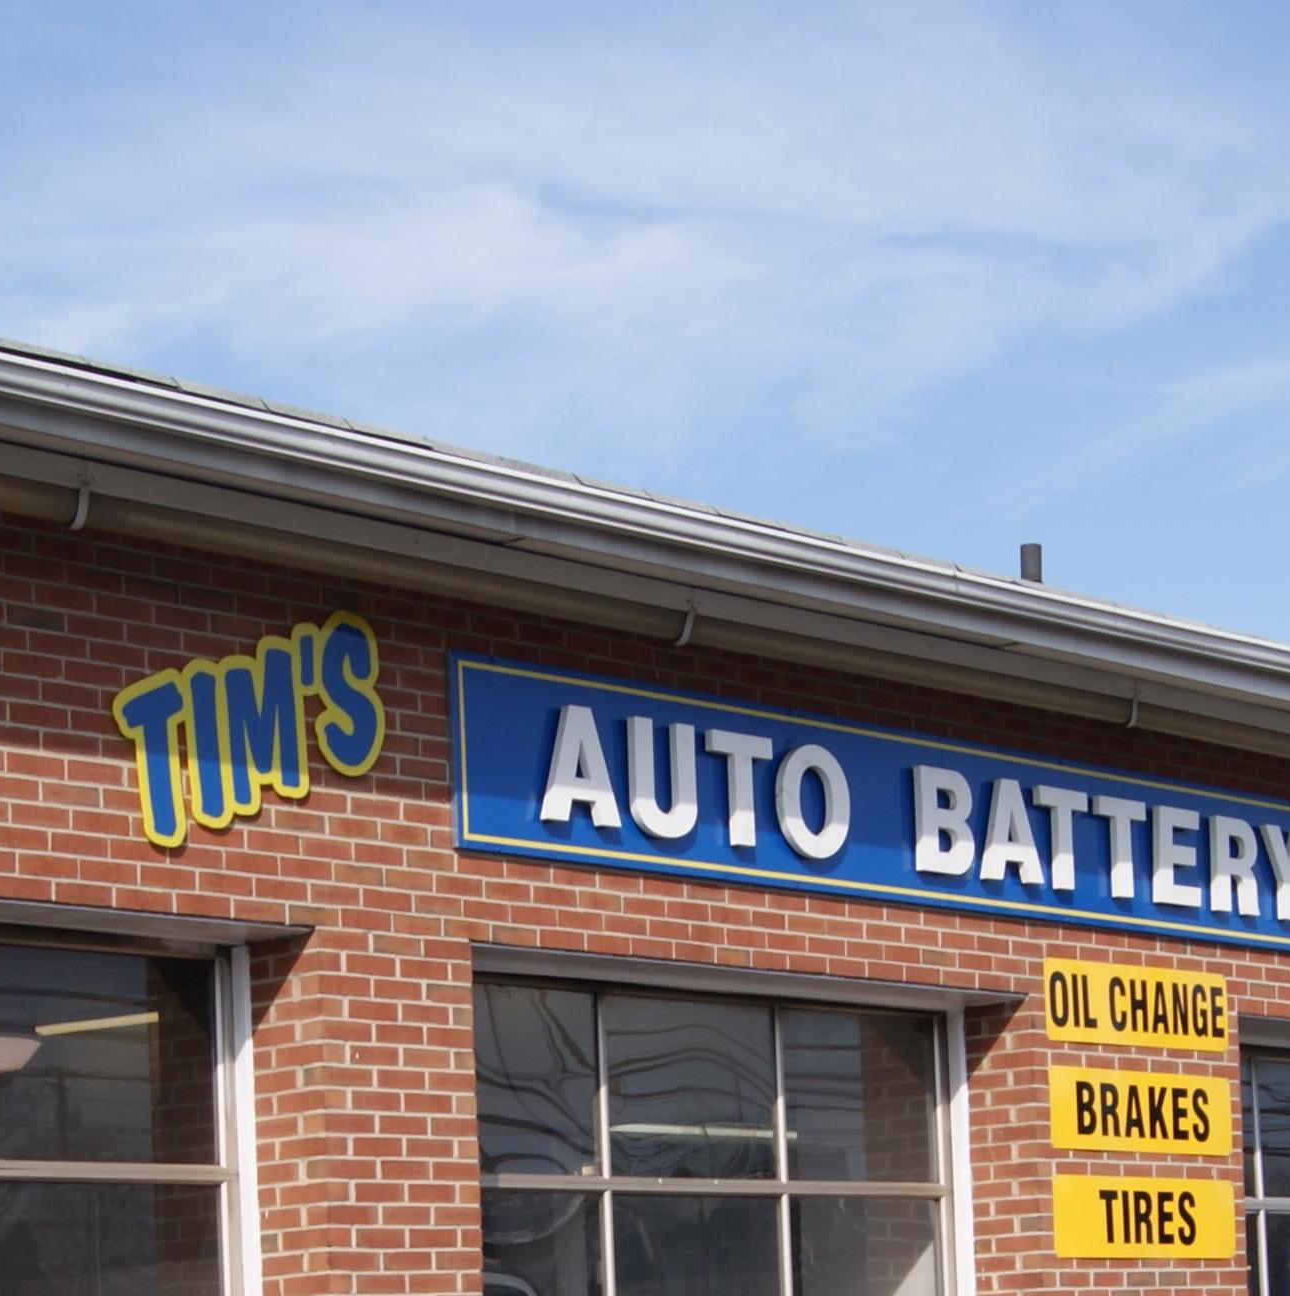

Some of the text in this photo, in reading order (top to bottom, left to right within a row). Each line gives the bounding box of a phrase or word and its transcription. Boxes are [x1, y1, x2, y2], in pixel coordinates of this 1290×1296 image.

[113, 610, 385, 847] TIM'S
[540, 704, 851, 861] AUTO
[1049, 970, 1225, 1038] OIL CHANGE
[1075, 1080, 1210, 1143] BRAKES
[1099, 1189, 1197, 1246] TIRES
